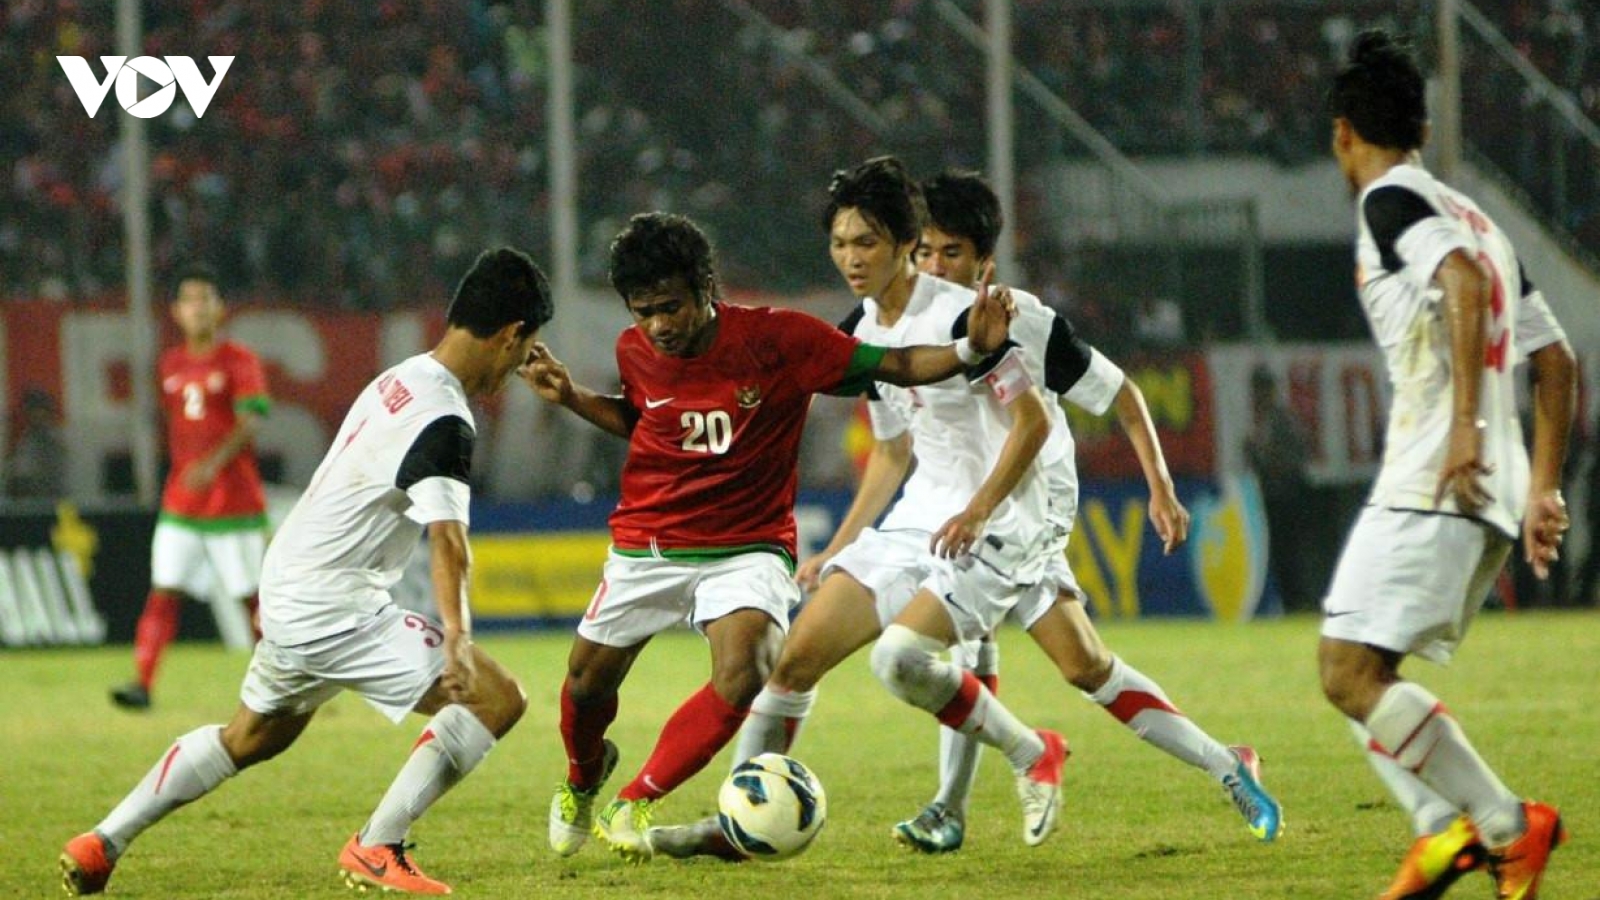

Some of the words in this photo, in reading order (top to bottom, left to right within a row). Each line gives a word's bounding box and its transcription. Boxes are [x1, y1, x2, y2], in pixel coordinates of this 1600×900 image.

[182, 382, 205, 421] 2
[680, 410, 733, 455] 20
[404, 613, 445, 649] 3
